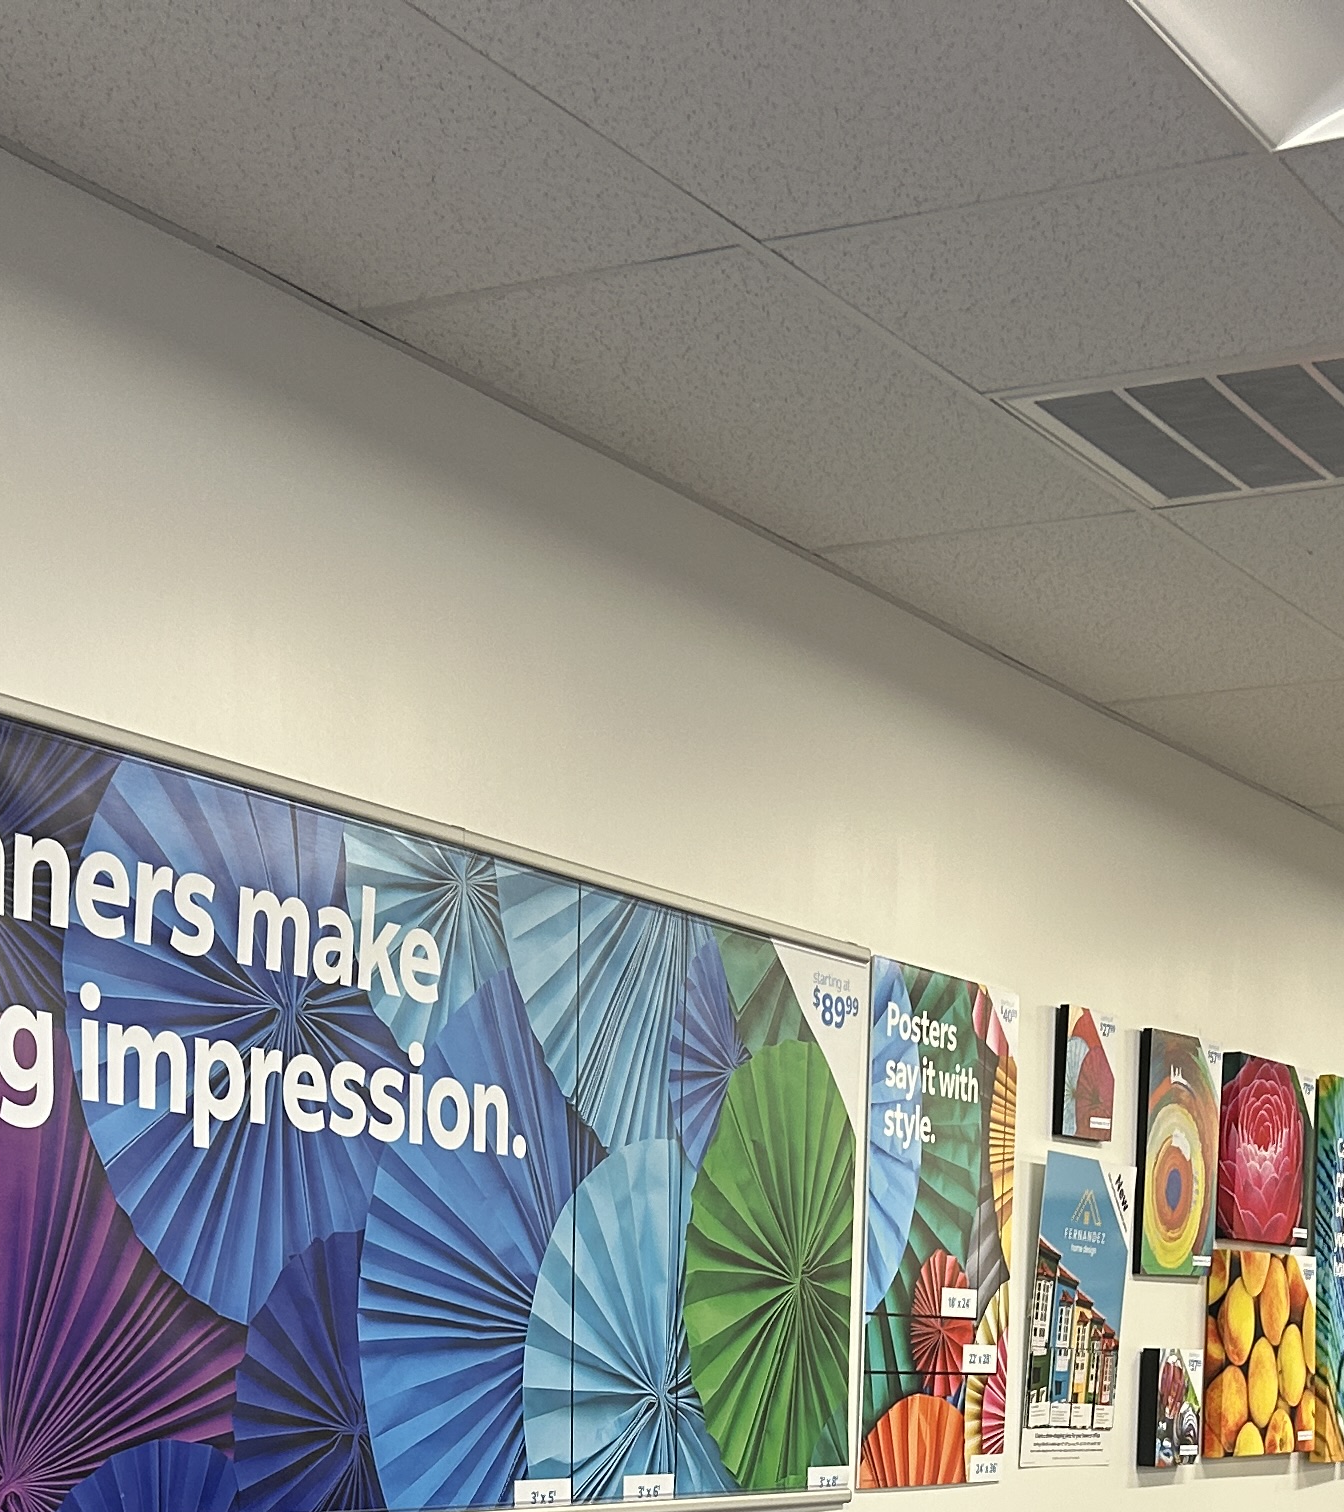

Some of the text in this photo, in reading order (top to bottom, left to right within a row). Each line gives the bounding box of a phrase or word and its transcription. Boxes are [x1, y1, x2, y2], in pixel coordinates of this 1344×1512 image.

[235, 883, 441, 1004] make
[813, 970, 850, 992] starting at
[887, 1001, 958, 1052] Posters
[79, 981, 527, 1159] impression.
[885, 1056, 979, 1104] say it with
[883, 1103, 936, 1149] style.
[1064, 1227, 1106, 1244] FERNANDEZ
